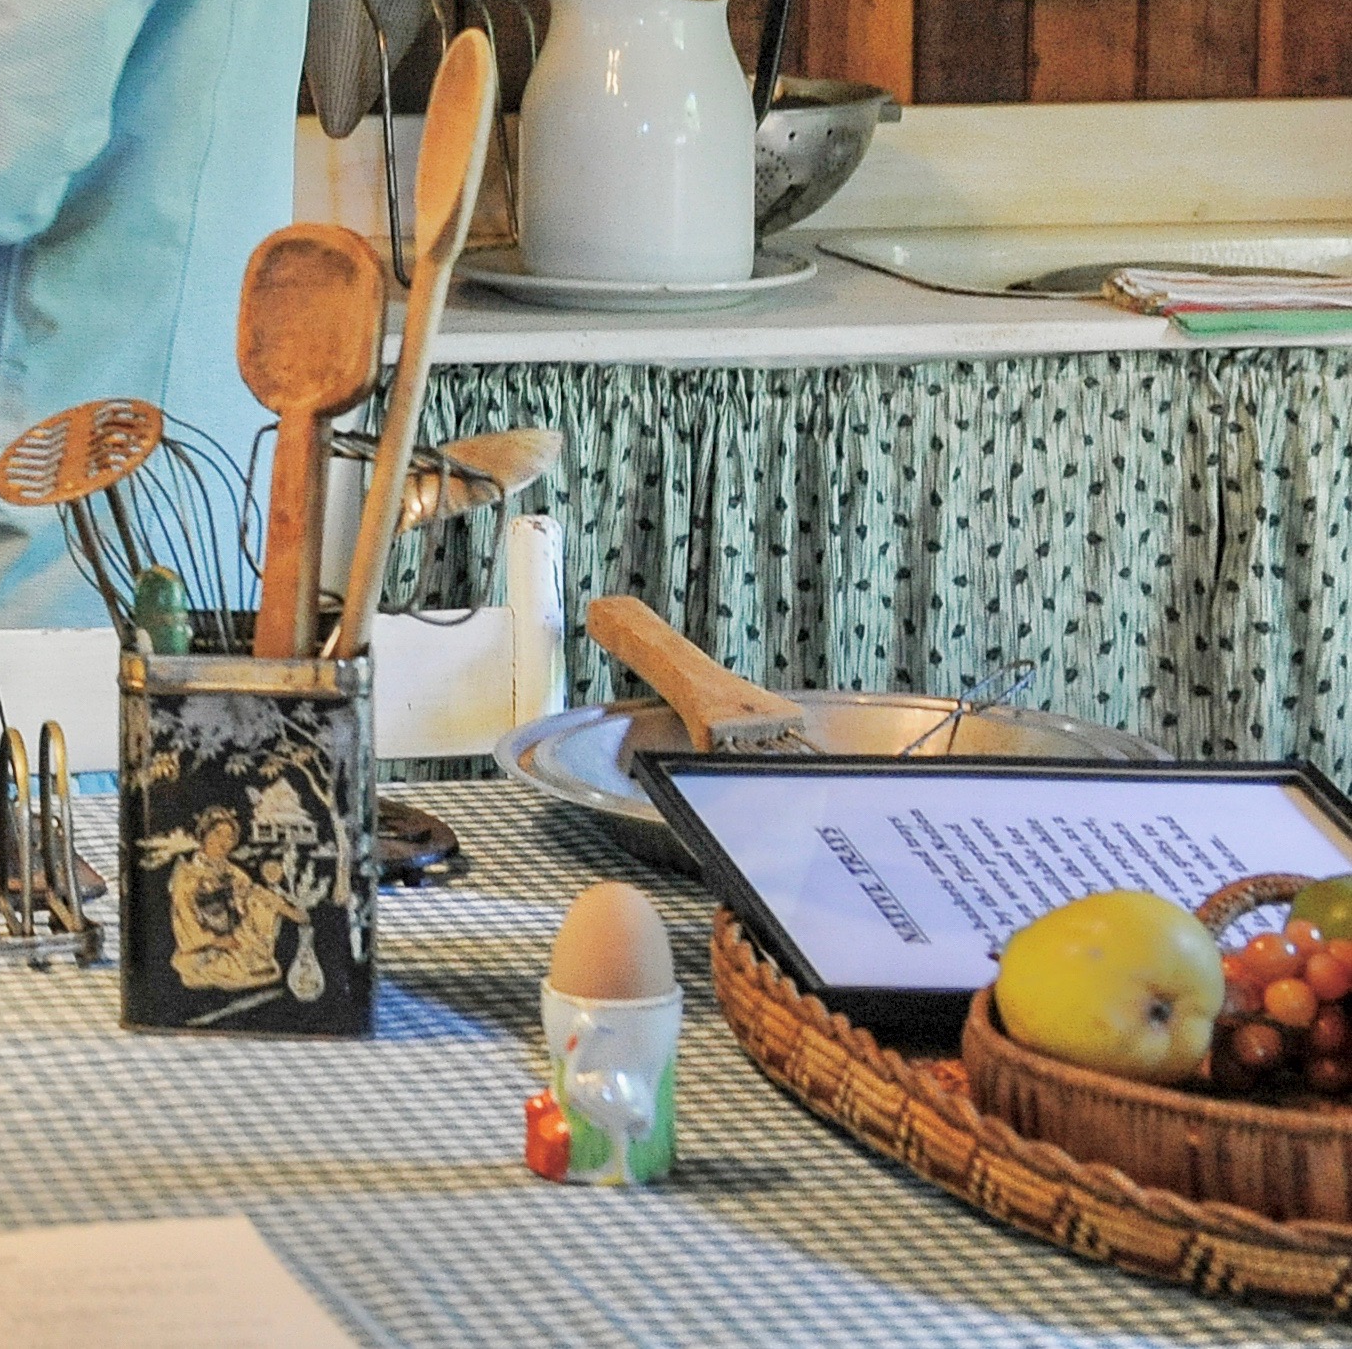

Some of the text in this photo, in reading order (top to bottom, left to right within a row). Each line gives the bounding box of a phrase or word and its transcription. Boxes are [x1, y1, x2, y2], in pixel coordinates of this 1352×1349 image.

[817, 827, 920, 943] NATIVE TRAYS
[911, 850, 945, 876] and
